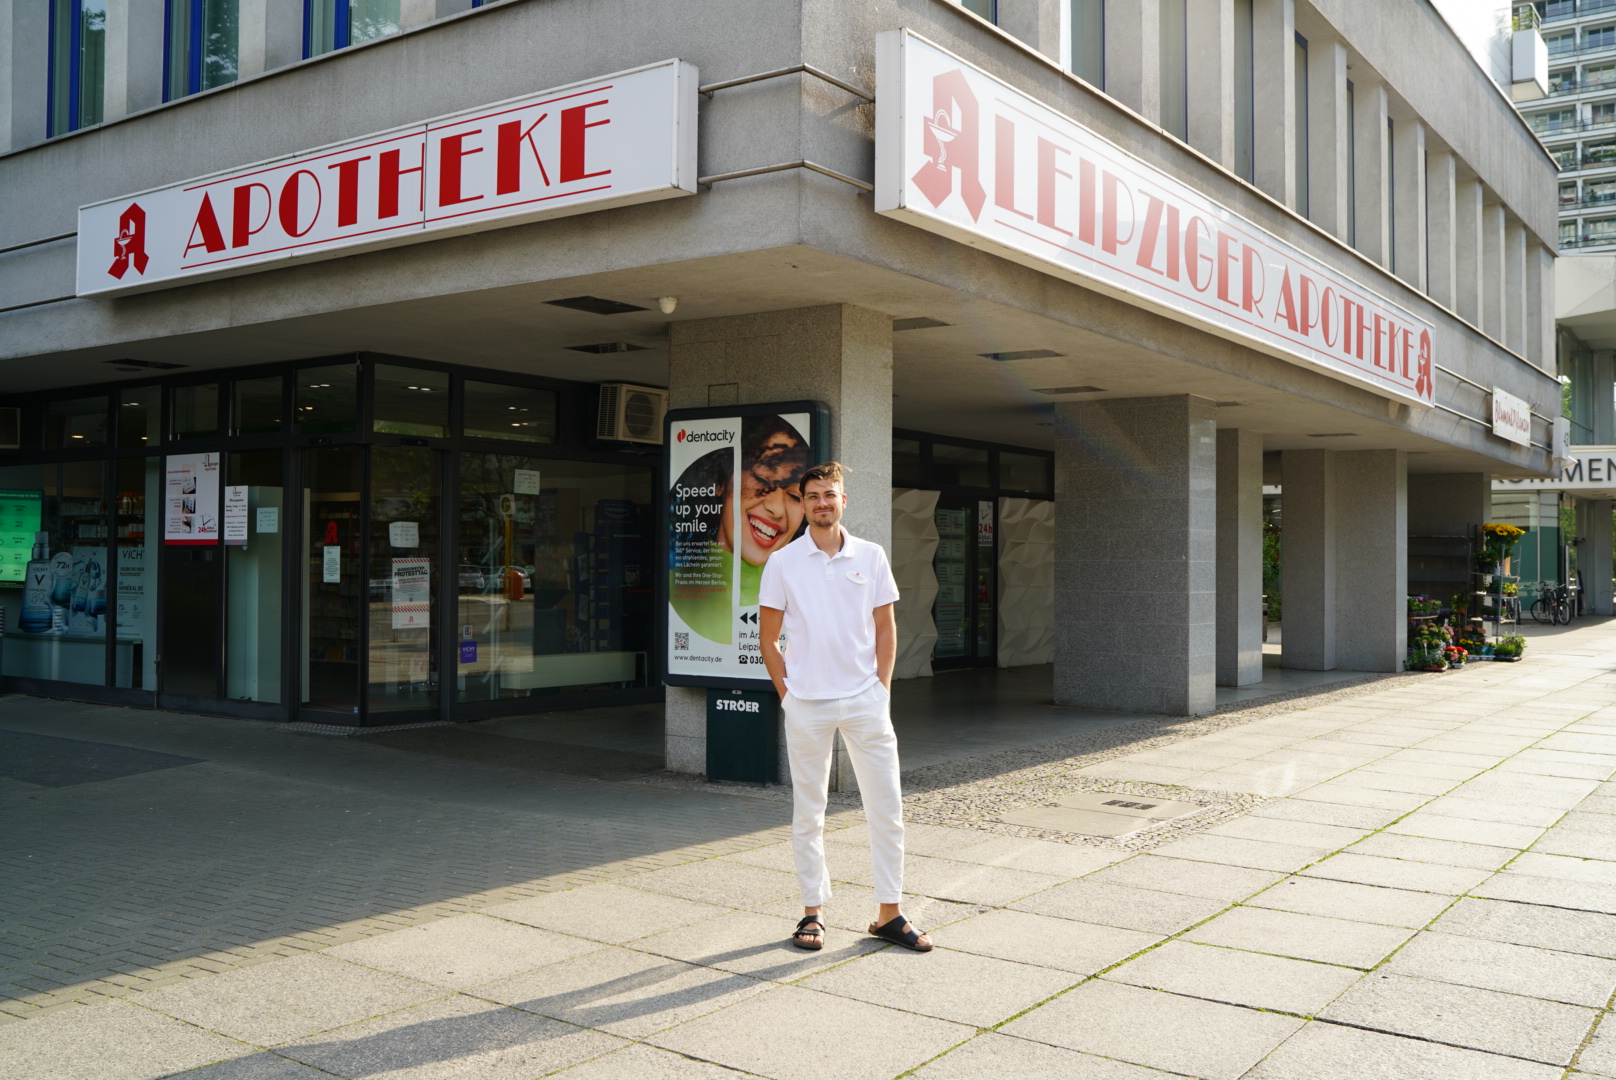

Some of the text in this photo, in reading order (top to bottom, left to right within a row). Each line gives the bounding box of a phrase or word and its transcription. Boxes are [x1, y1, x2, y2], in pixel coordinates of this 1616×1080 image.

[183, 99, 612, 258] APOTHEKE
[994, 113, 1264, 319] LEIPZIGER
[1274, 263, 1415, 381] APOTHEKE
[687, 430, 735, 443] dentacity
[676, 483, 716, 501] Speed
[676, 504, 723, 518] up your
[675, 518, 707, 533] smile
[979, 522, 992, 534] 24h
[122, 549, 145, 560] VICH
[709, 555, 723, 563] gesun-
[739, 631, 747, 639] im
[739, 642, 760, 653] Leipzi
[674, 654, 722, 663] www.dentacity.de
[716, 699, 760, 713] STRÖER
